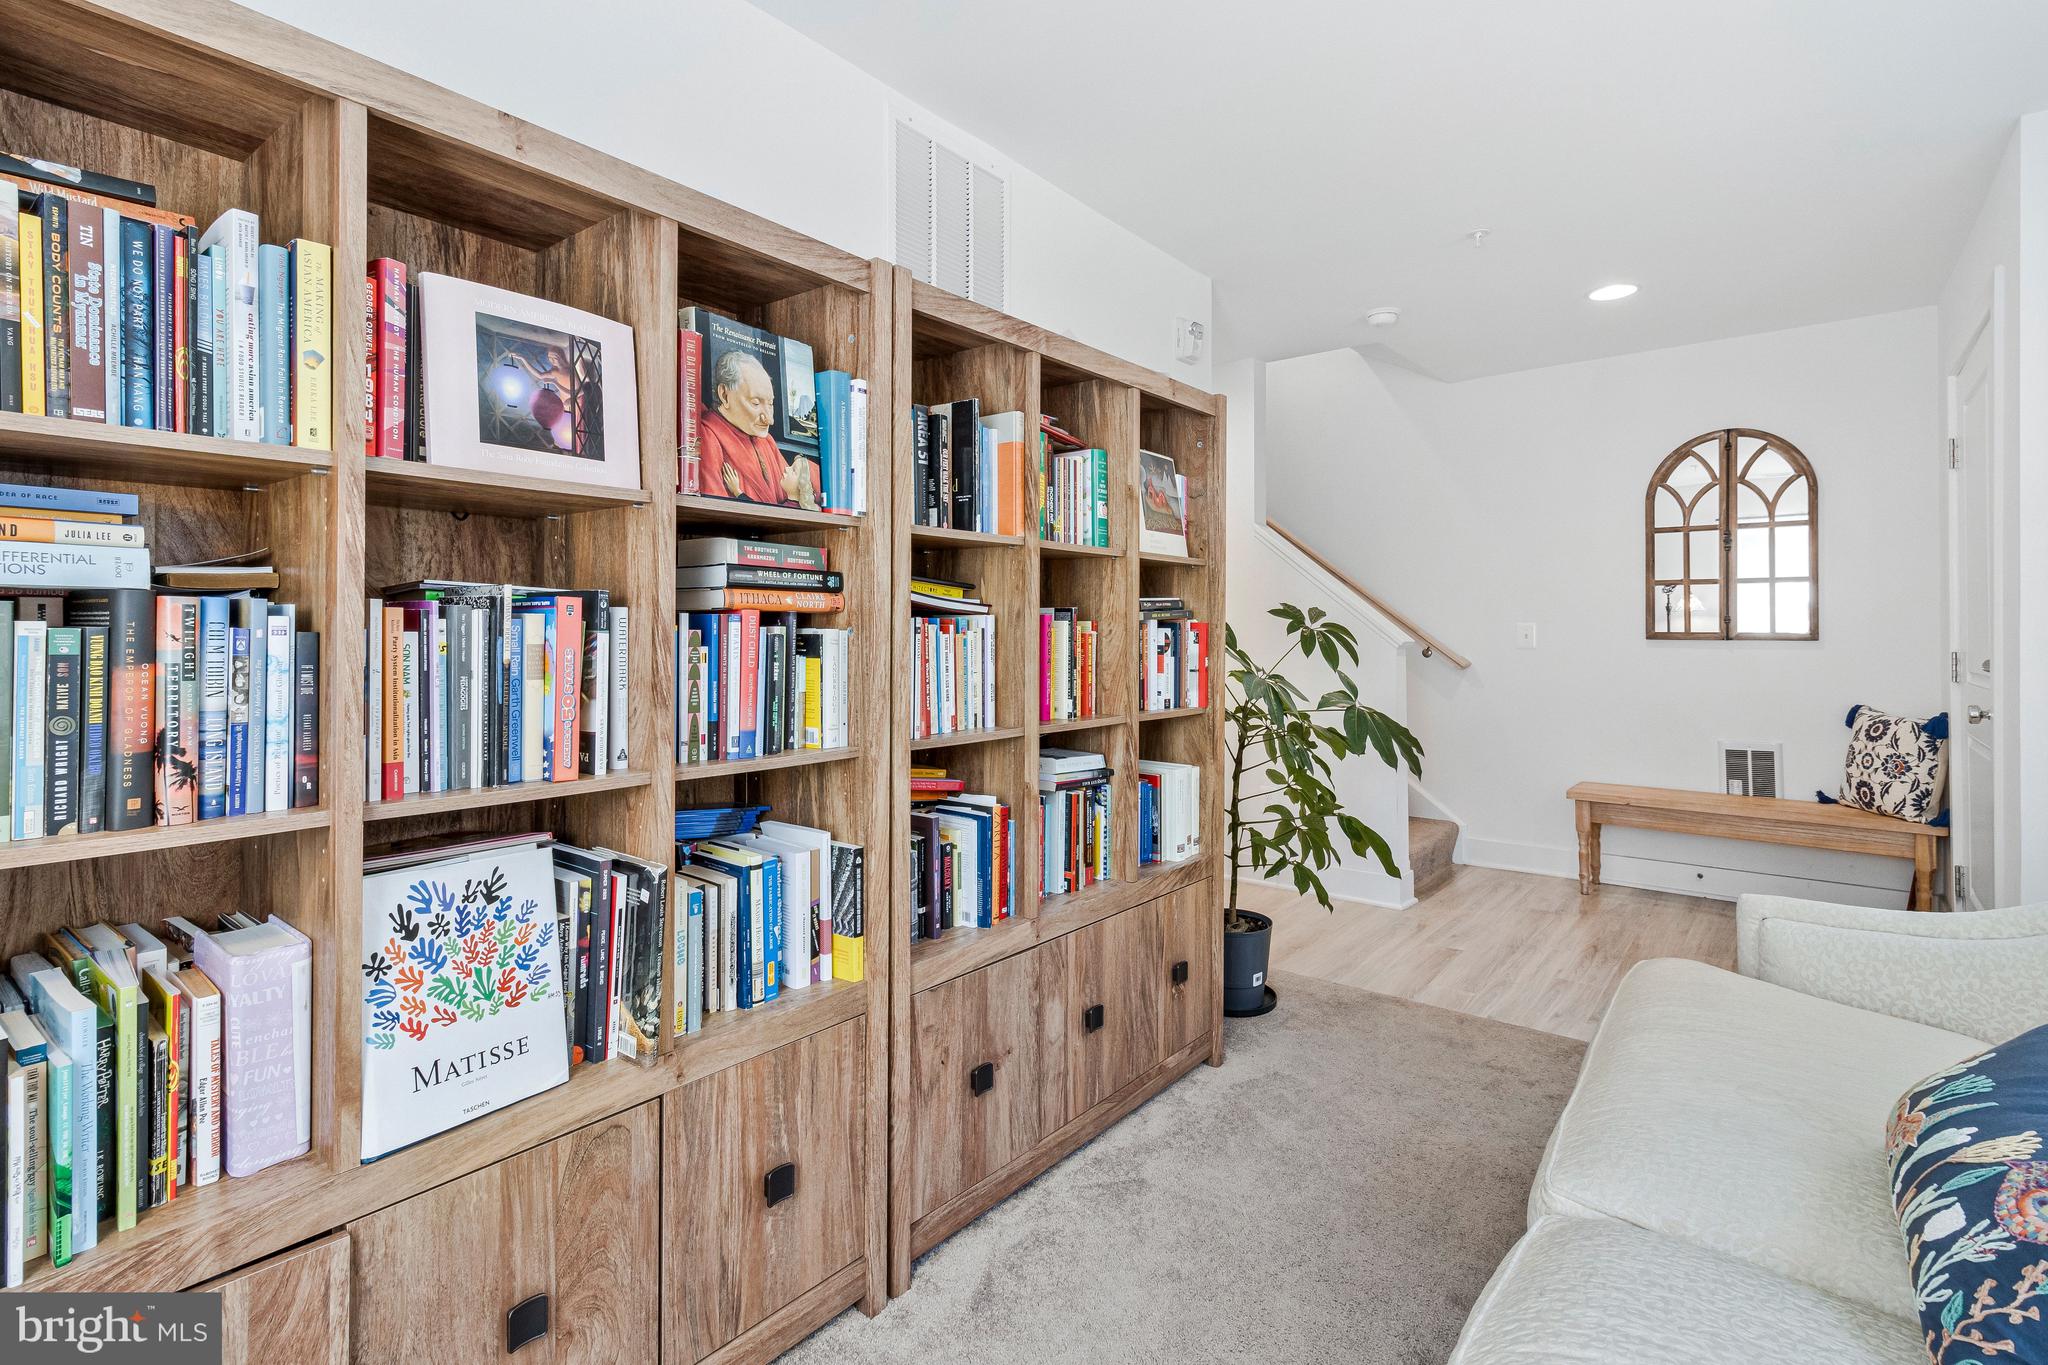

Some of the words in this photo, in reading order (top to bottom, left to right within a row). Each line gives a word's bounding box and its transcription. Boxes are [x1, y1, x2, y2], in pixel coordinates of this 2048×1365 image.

[80, 225, 93, 247] TIN
[133, 241, 144, 255] WE
[5, 241, 13, 269] HISTORY
[51, 233, 61, 271] BODY
[276, 253, 286, 269] Vinh
[5, 272, 13, 282] ON
[88, 262, 102, 293] State
[133, 259, 144, 274] DO
[199, 257, 211, 289] JAMES
[303, 249, 313, 284] ASIAN
[5, 284, 13, 298] THE
[72, 274, 87, 287] in
[133, 279, 144, 298] NOT
[276, 271, 286, 298] Nguyen
[5, 300, 13, 314] RUN
[51, 275, 61, 333] COUNTS
[276, 302, 286, 315] The
[315, 277, 324, 324] MAKING
[365, 283, 373, 318] GEORGE
[72, 290, 87, 350] Myanmar
[133, 303, 144, 330] PART
[199, 295, 211, 340] BALDWIN
[216, 308, 224, 325] YOU
[246, 312, 255, 340] eating
[303, 289, 313, 344] AMERICA
[88, 296, 102, 366] Dominance
[216, 328, 224, 344] ARE
[276, 317, 286, 346] Migrant
[365, 322, 373, 357] ORWELL
[711, 322, 725, 332] The
[724, 326, 756, 344] Renaissance
[756, 338, 777, 351] Portrait
[216, 347, 224, 367] HERE
[246, 342, 255, 362] more
[276, 349, 286, 365] Rain
[392, 346, 400, 361] THE
[686, 339, 696, 352] THE
[133, 356, 144, 377] HAN
[686, 355, 696, 366] DA
[246, 364, 255, 386] asian
[276, 367, 286, 384] Falls
[392, 363, 400, 392] HUMAN
[686, 367, 696, 389] VINCI
[133, 382, 144, 411] KANG
[309, 377, 318, 404] ERIKA
[686, 391, 696, 411] CODE
[246, 387, 255, 421] america
[276, 395, 286, 424] Reverse
[309, 406, 318, 421] LEE
[392, 395, 400, 441] CONDITION
[686, 418, 696, 432] DAN
[917, 411, 928, 447] AREA
[917, 450, 928, 465] 51
[65, 530, 92, 540] JULIA
[96, 531, 112, 542] LEE
[757, 570, 780, 578] WHEEL
[793, 572, 824, 581] FORTUNE
[739, 592, 782, 605] ITHACA
[795, 592, 826, 600] CLAIRE
[796, 600, 825, 608] NORTH
[125, 622, 134, 642] THE
[511, 625, 521, 653] Small
[748, 616, 757, 639] DUST
[184, 607, 195, 680] TWILIGHT
[391, 636, 399, 653] Party
[619, 617, 628, 691] WATERMARK
[748, 641, 757, 667] CHILD
[56, 662, 69, 677] SON
[124, 648, 133, 701] EMPEROR
[391, 655, 399, 676] System
[511, 655, 521, 676] Rain
[563, 648, 574, 694] STATES
[139, 663, 149, 700] OCEAN
[511, 678, 522, 704] Garth
[56, 683, 69, 710] NATIVE
[166, 665, 178, 747] TERRITORY
[391, 677, 399, 738] Institutionalization
[561, 695, 575, 721] 50
[124, 708, 133, 721] OF
[139, 706, 149, 744] VUONG
[205, 718, 226, 746] LONG
[511, 706, 522, 761] Greenwell
[55, 739, 69, 775] WRIGHT
[123, 728, 132, 788] GLADNESS
[391, 748, 399, 760] Asia
[205, 750, 226, 790] ISLAND
[55, 780, 69, 820] RICHARD
[658, 879, 666, 900] Robert
[658, 902, 666, 917] Louis
[658, 918, 666, 947] Stevenson
[579, 955, 587, 989] nimrods
[231, 1016, 242, 1048] CUTE
[96, 1038, 112, 1070] HARRY
[210, 1039, 221, 1063] TALES
[79, 1061, 92, 1081] The
[210, 1064, 221, 1074] OF
[242, 1064, 283, 1086] FUN
[412, 1035, 530, 1094] MATISSE
[199, 1078, 208, 1095] Edgar
[210, 1075, 221, 1110] MYSTERY
[79, 1083, 92, 1122] Working
[199, 1096, 208, 1113] Allan
[463, 1100, 490, 1115] TASCHEN
[27, 1109, 38, 1124] The
[199, 1114, 208, 1124] Poe
[210, 1111, 221, 1126] AND
[26, 1126, 37, 1171] soul-selling
[79, 1123, 92, 1153] Writer
[210, 1128, 221, 1158] TERROR
[26, 1172, 37, 1186] guy
